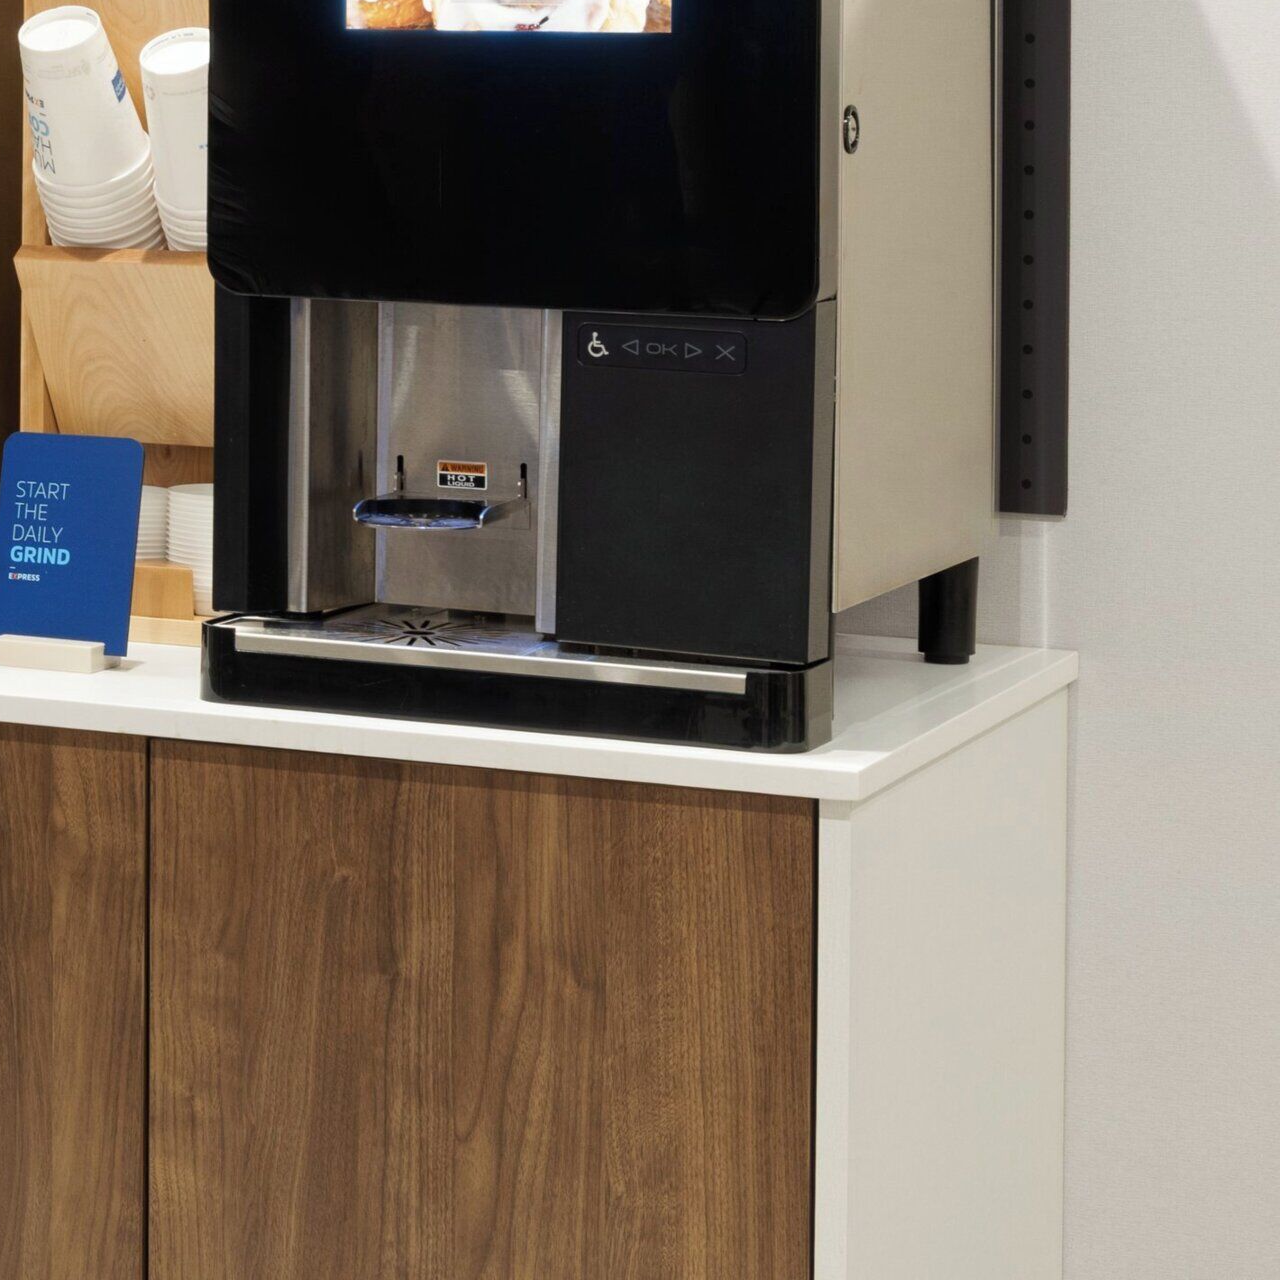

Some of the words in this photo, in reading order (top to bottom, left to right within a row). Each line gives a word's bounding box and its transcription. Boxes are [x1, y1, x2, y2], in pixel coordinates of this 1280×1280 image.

[646, 342, 678, 356] OK
[447, 474, 476, 482] HOT
[15, 480, 71, 500] START
[14, 502, 48, 521] THE
[12, 523, 64, 544] DAILY
[9, 545, 71, 566] GRIND
[8, 572, 40, 582] EXPRESS
